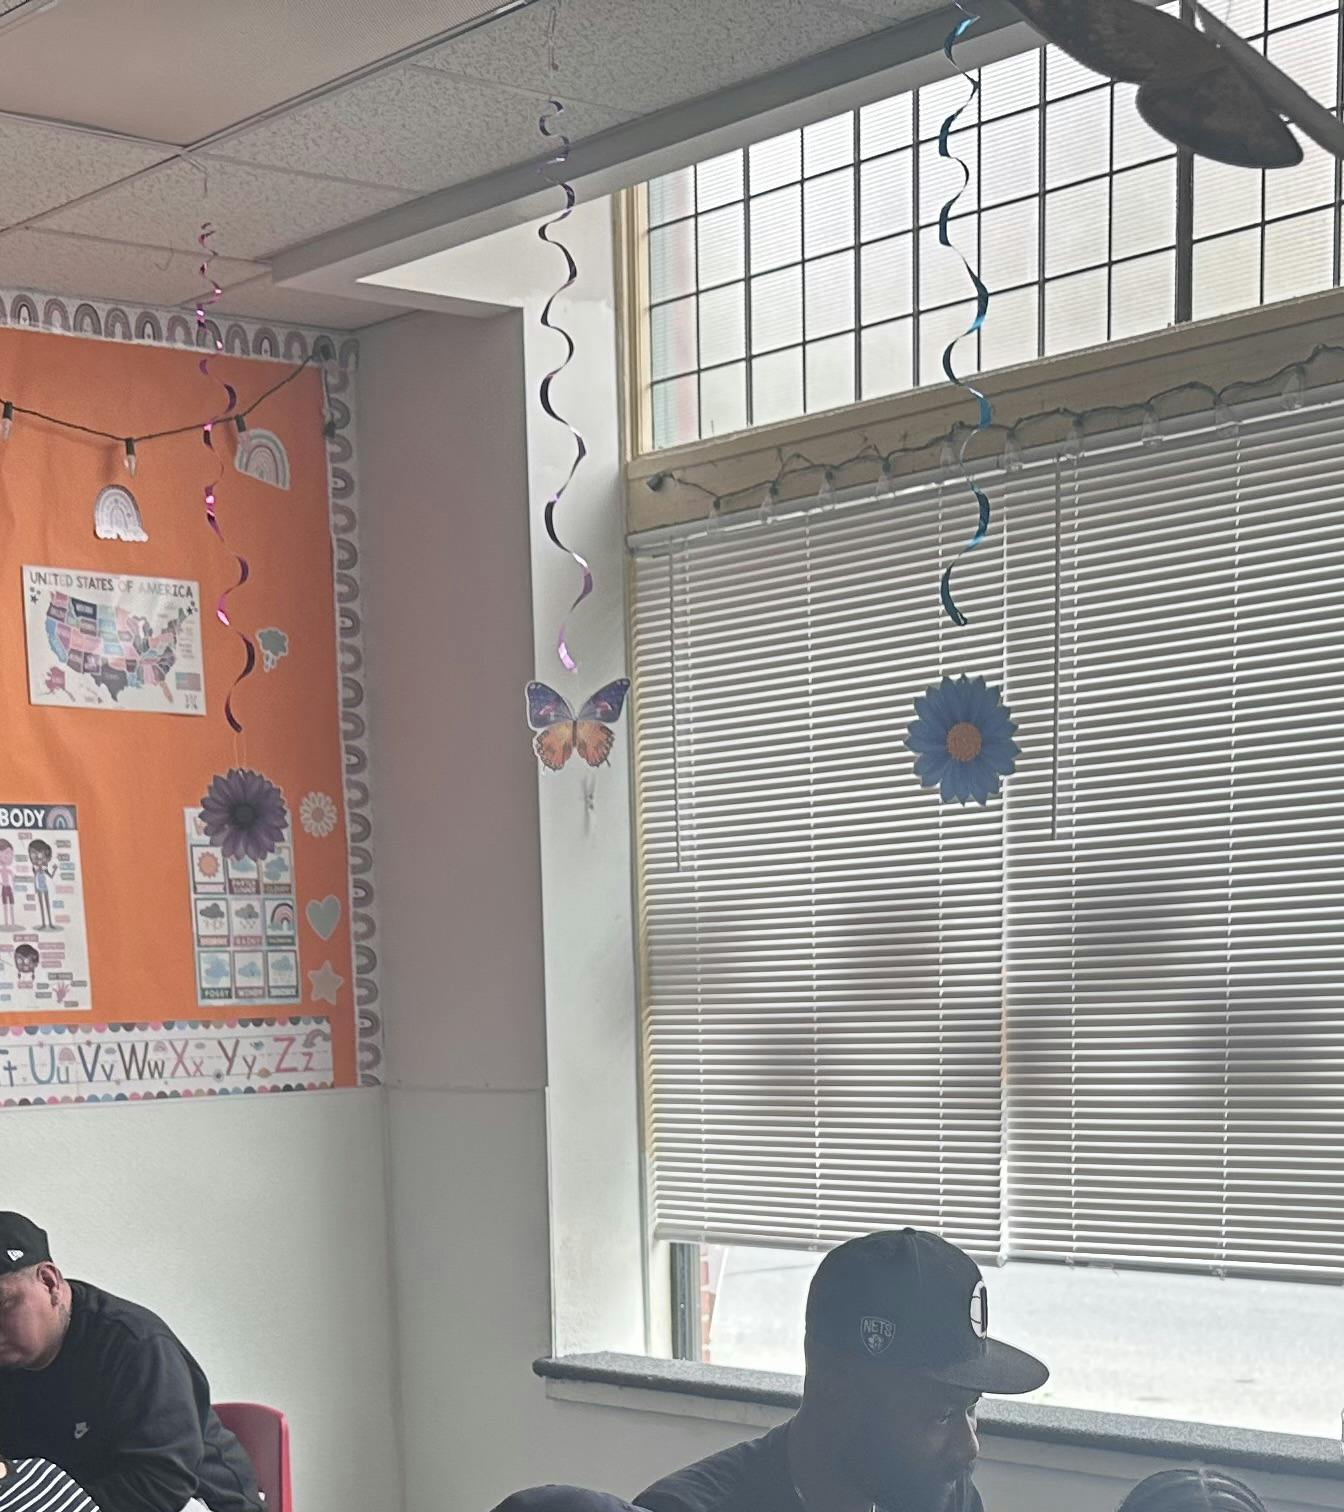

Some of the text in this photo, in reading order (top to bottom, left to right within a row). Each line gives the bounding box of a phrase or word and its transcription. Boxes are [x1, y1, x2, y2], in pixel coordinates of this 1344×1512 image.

[30, 571, 193, 598] UNITED STATES OF AMERICA
[864, 1319, 893, 1338] NETS
